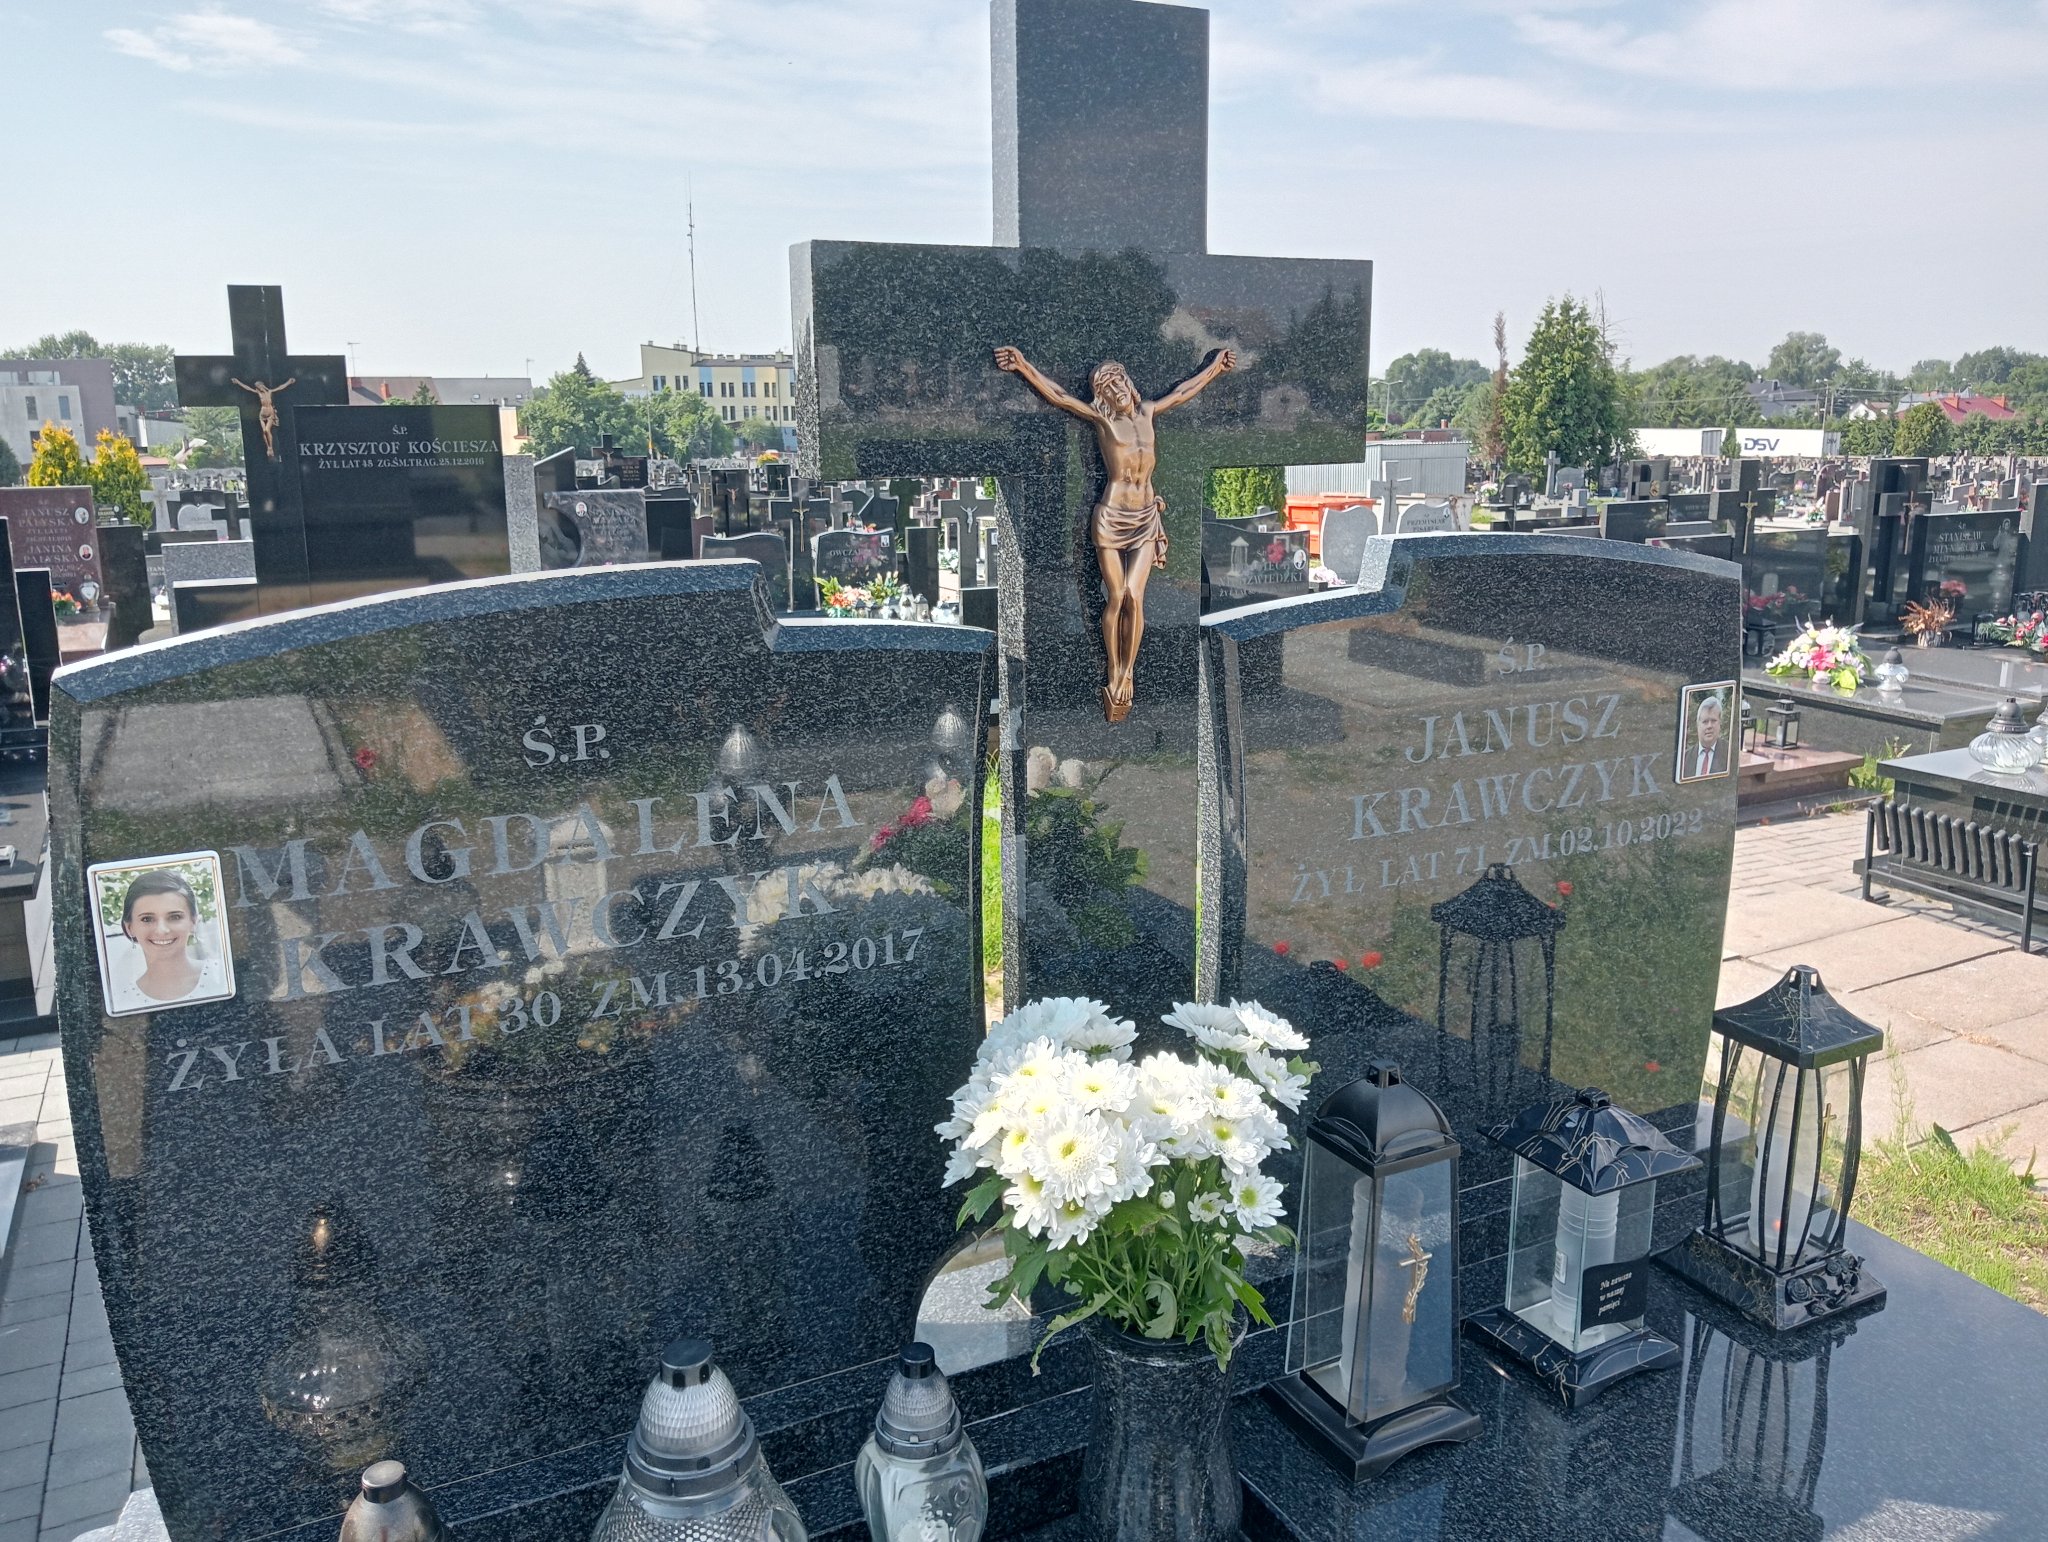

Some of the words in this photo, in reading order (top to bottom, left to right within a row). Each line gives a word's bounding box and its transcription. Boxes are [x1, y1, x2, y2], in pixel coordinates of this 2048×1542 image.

[300, 441, 400, 456] KRZYSZTOF
[407, 437, 500, 454] KOŚCIESZA
[342, 459, 361, 468] LAT
[1744, 437, 1780, 451] DSV
[522, 715, 611, 769] Ś.P.
[1404, 693, 1622, 764] JANUSZ
[1347, 752, 1663, 842] KRAWCZYK
[225, 773, 864, 908] MAGDALENA
[1292, 864, 1364, 902] ŻYŁ
[1379, 851, 1446, 888] LAT
[1455, 846, 1489, 875] 71
[274, 861, 841, 1001] KRAWCZYK
[165, 1027, 348, 1092] ŻYŁA
[366, 1005, 485, 1057] LAT
[500, 992, 562, 1034] 30
